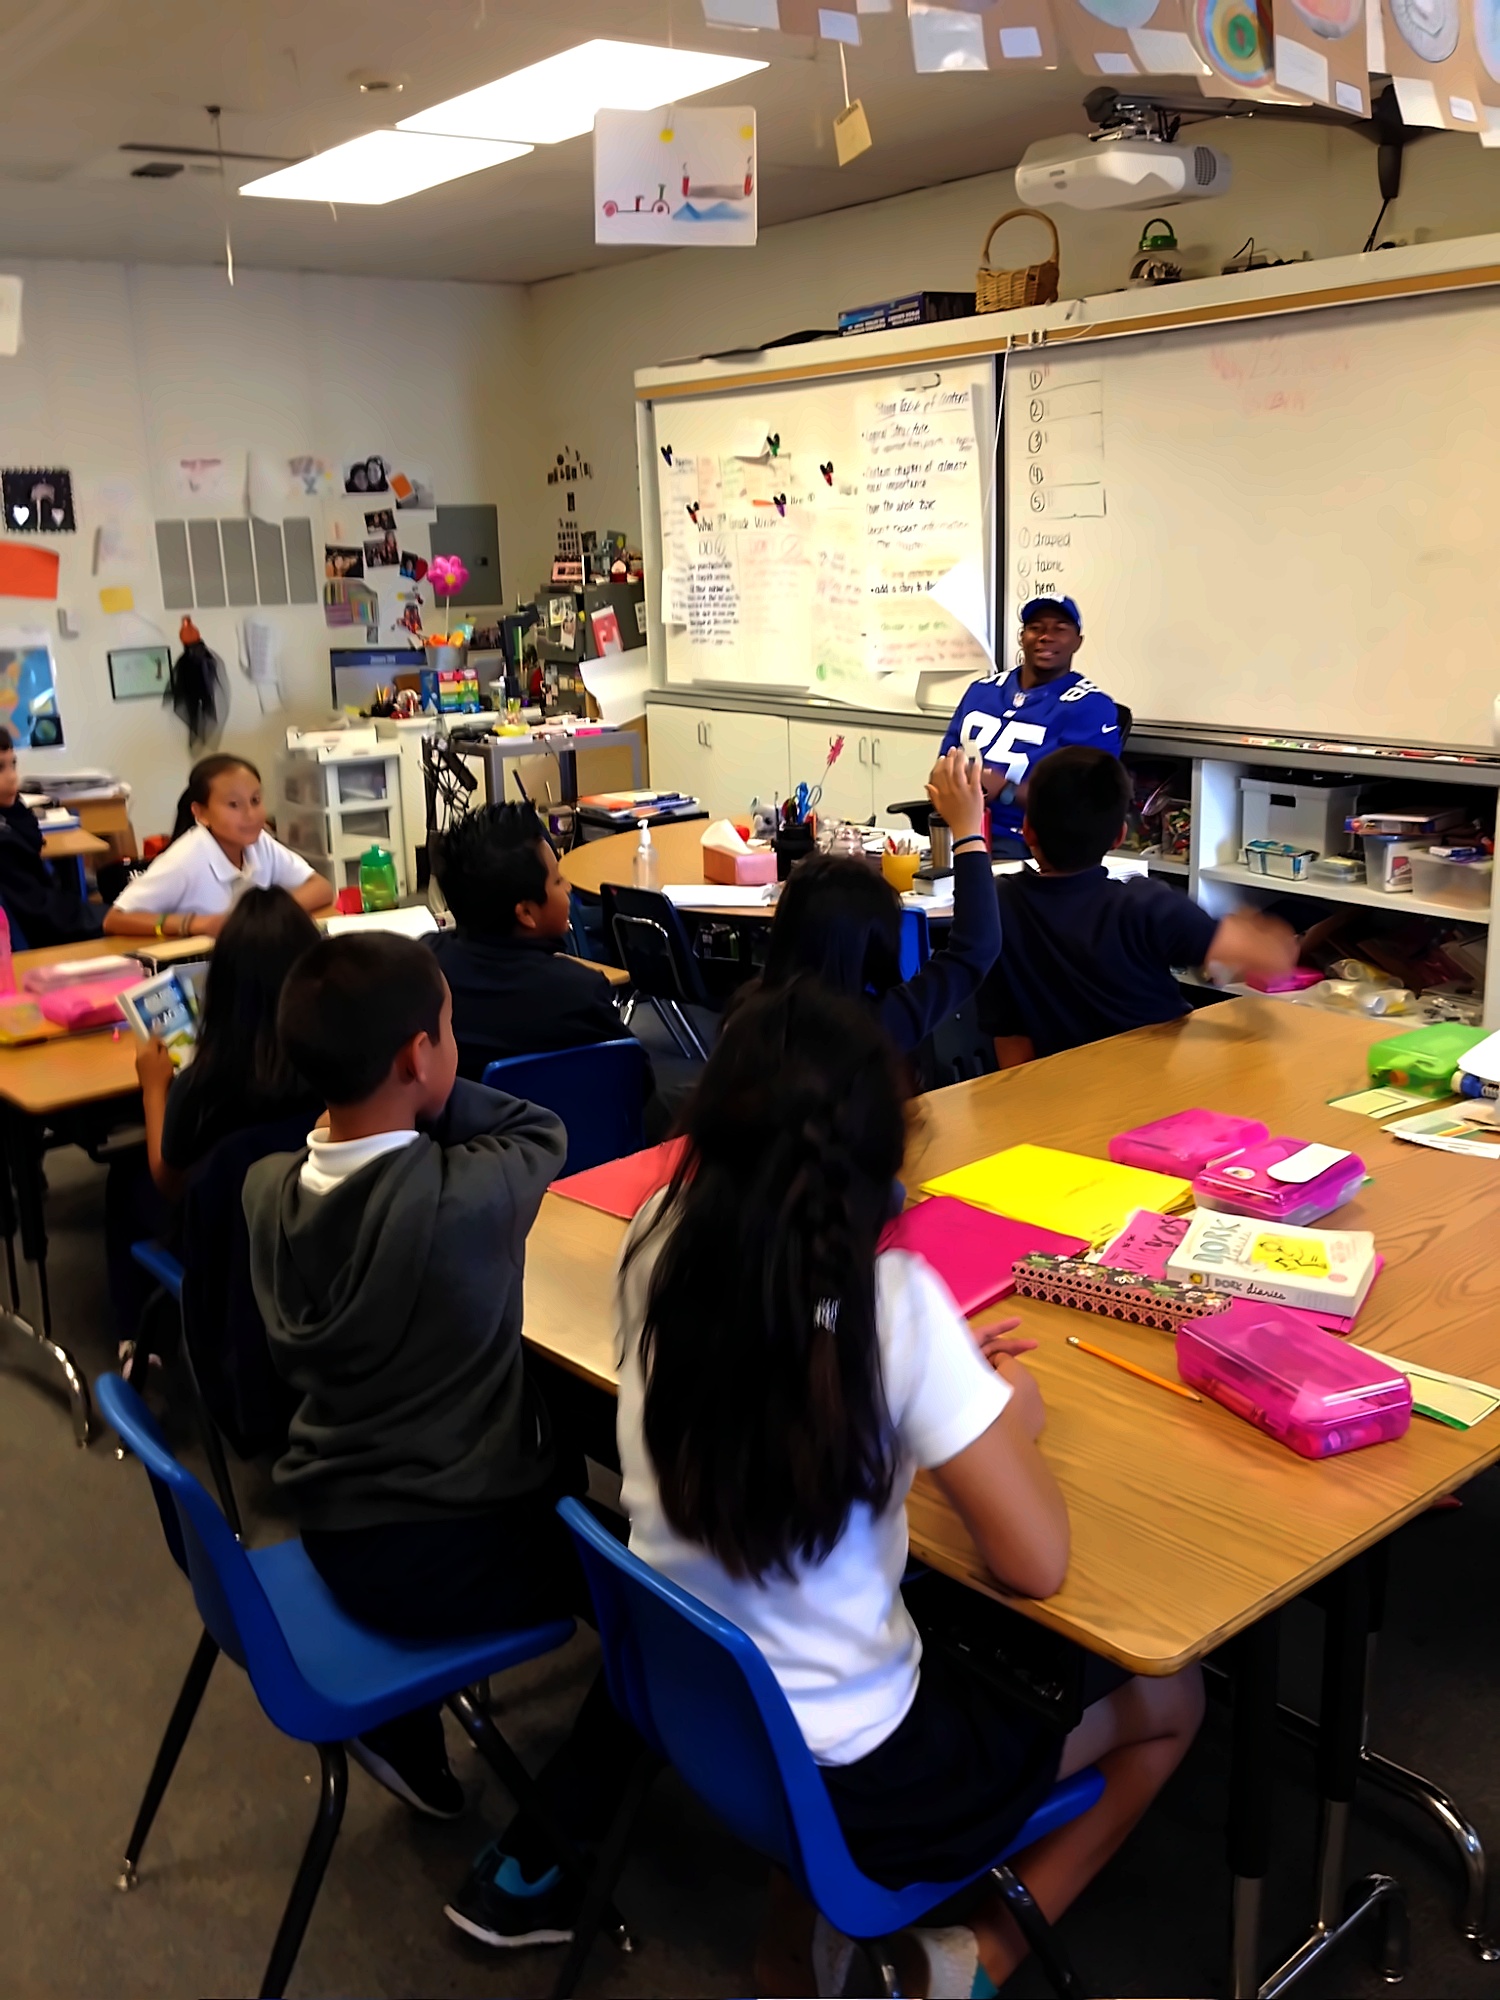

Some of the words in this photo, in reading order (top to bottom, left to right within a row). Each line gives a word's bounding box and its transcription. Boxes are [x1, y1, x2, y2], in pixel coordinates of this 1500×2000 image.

[1033, 532, 1071, 547] draped
[1035, 554, 1065, 573] fabric
[1035, 581, 1056, 595] hem
[1193, 1219, 1240, 1264] DORK
[1214, 1278, 1243, 1291] DORK
[1246, 1282, 1286, 1300] diaries
